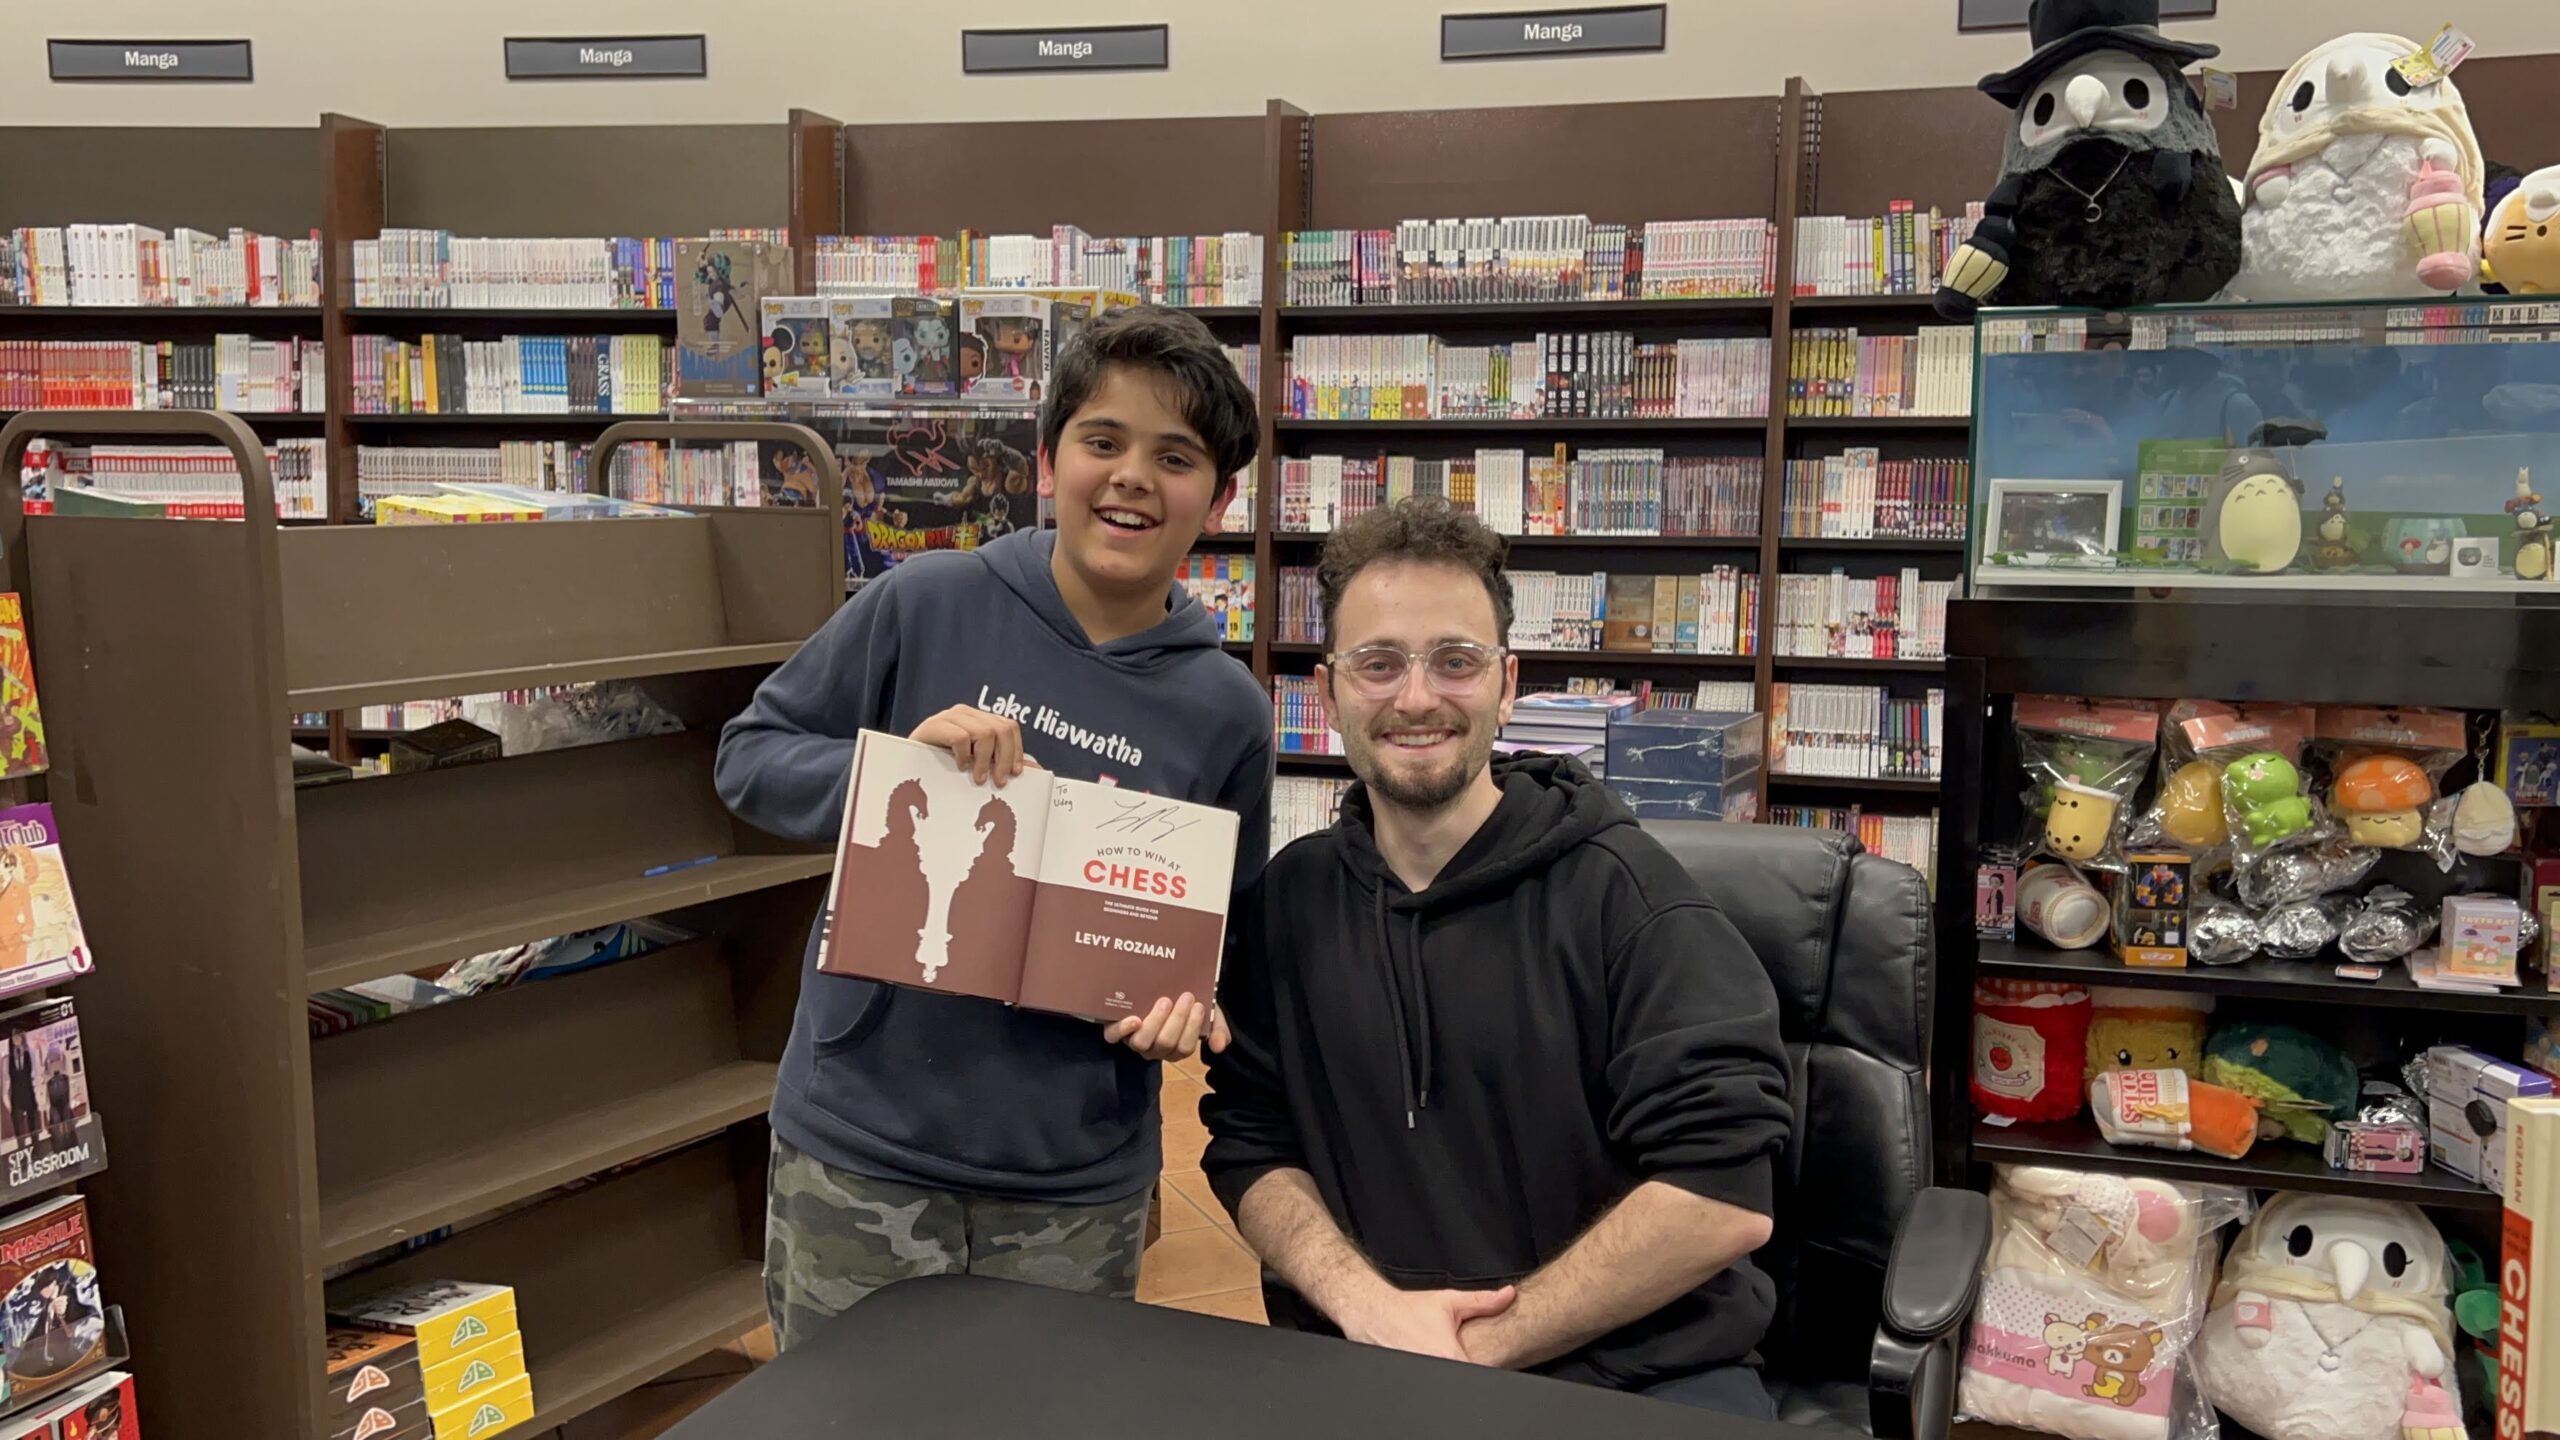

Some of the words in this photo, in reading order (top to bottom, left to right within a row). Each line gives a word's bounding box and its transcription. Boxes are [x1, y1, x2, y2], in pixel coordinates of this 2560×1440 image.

[1524, 24, 1583, 42] Manga
[125, 51, 178, 70] Manga
[580, 48, 632, 67] Manga
[1038, 40, 1092, 58] Manga
[598, 354, 610, 397] GRASS
[867, 519, 926, 550] DRAGON
[978, 685, 1032, 725] Lake
[1033, 705, 1143, 767] Hiawatha
[1056, 784, 1068, 796] To
[1097, 847, 1124, 857] HOW
[1127, 848, 1141, 857] TO
[1145, 850, 1166, 865] WIN
[1168, 861, 1182, 872] AT
[1083, 859, 1187, 899] CHESS
[72, 946, 85, 969] 1
[1075, 931, 1111, 948] LEVY
[1113, 938, 1176, 960] ROZMAN
[60, 1002, 74, 1017] 01
[8, 1146, 34, 1171] SPY
[9, 1142, 89, 1188] CLASSROOM
[2514, 1124, 2525, 1204] ROZMAN
[0, 1213, 84, 1265] MASHLE
[2500, 1259, 2526, 1440] CHESS
